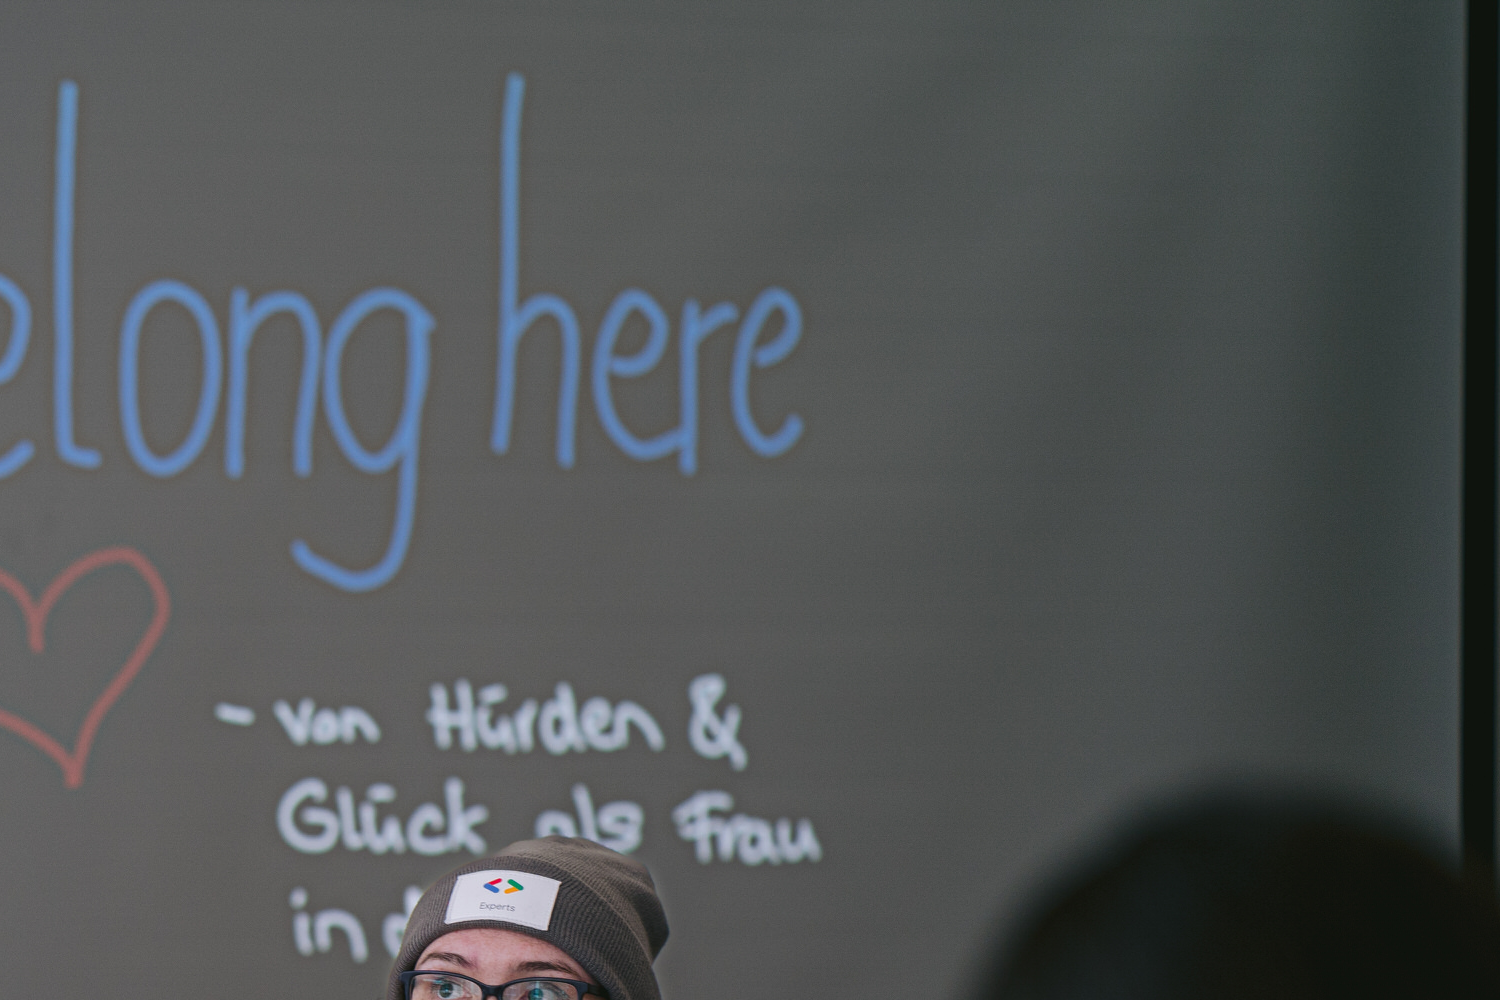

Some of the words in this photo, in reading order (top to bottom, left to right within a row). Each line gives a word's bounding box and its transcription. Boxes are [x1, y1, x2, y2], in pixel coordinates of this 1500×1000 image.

[491, 73, 803, 475] here
[427, 680, 665, 755] Hürden
[689, 674, 748, 770] &
[276, 777, 488, 855] Glück
[672, 790, 821, 865] Frau
[290, 887, 368, 963] in
[479, 901, 516, 911] Experts
